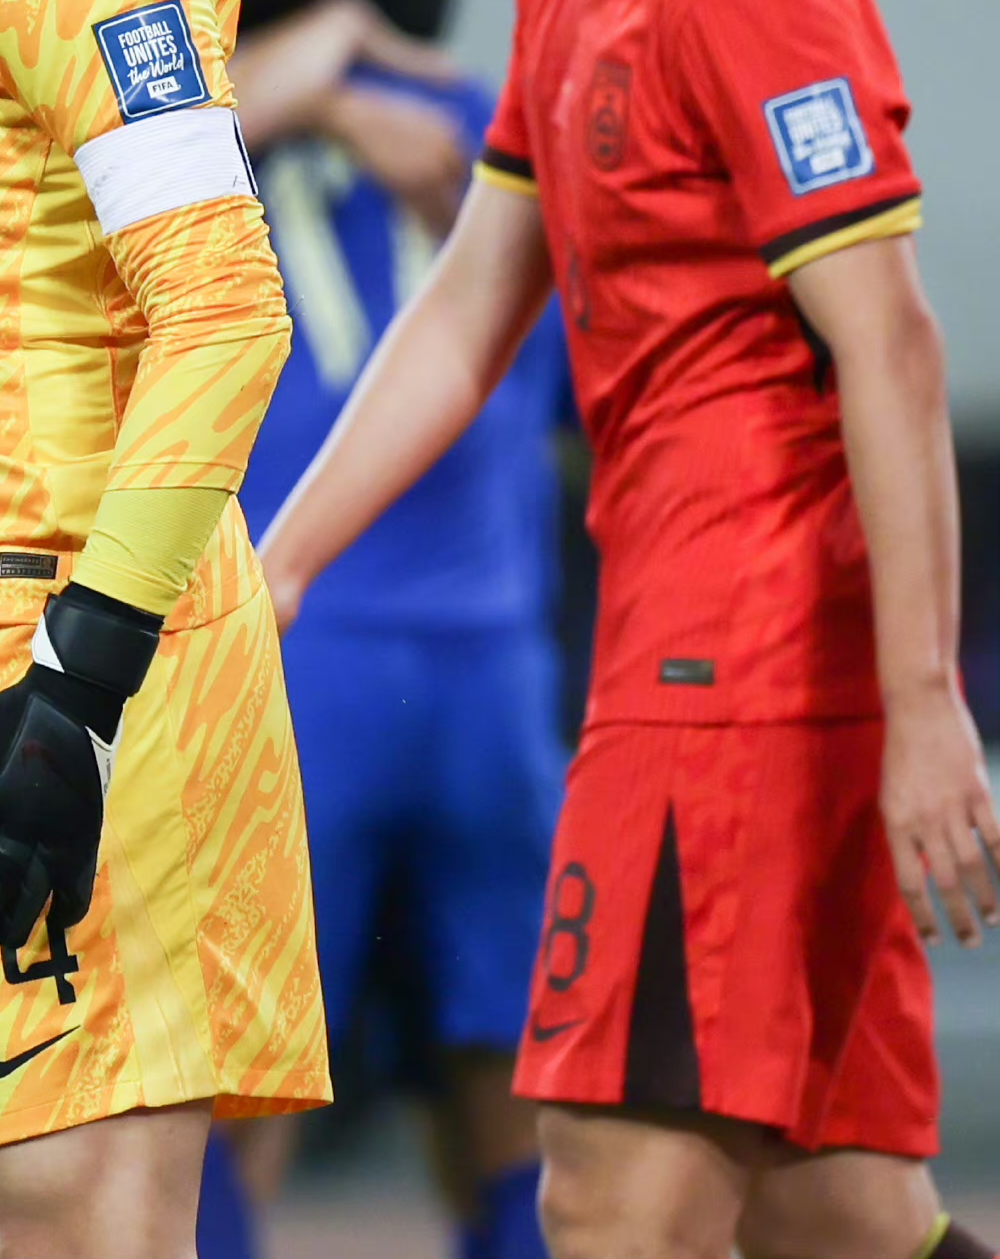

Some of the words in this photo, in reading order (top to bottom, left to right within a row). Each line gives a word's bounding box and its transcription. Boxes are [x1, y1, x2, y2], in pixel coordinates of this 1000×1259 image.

[118, 20, 172, 48] FOOTBALL
[122, 34, 178, 67] UNITES
[127, 68, 150, 85] the
[150, 53, 184, 77] World
[152, 81, 173, 92] FIFA
[544, 861, 597, 992] 8
